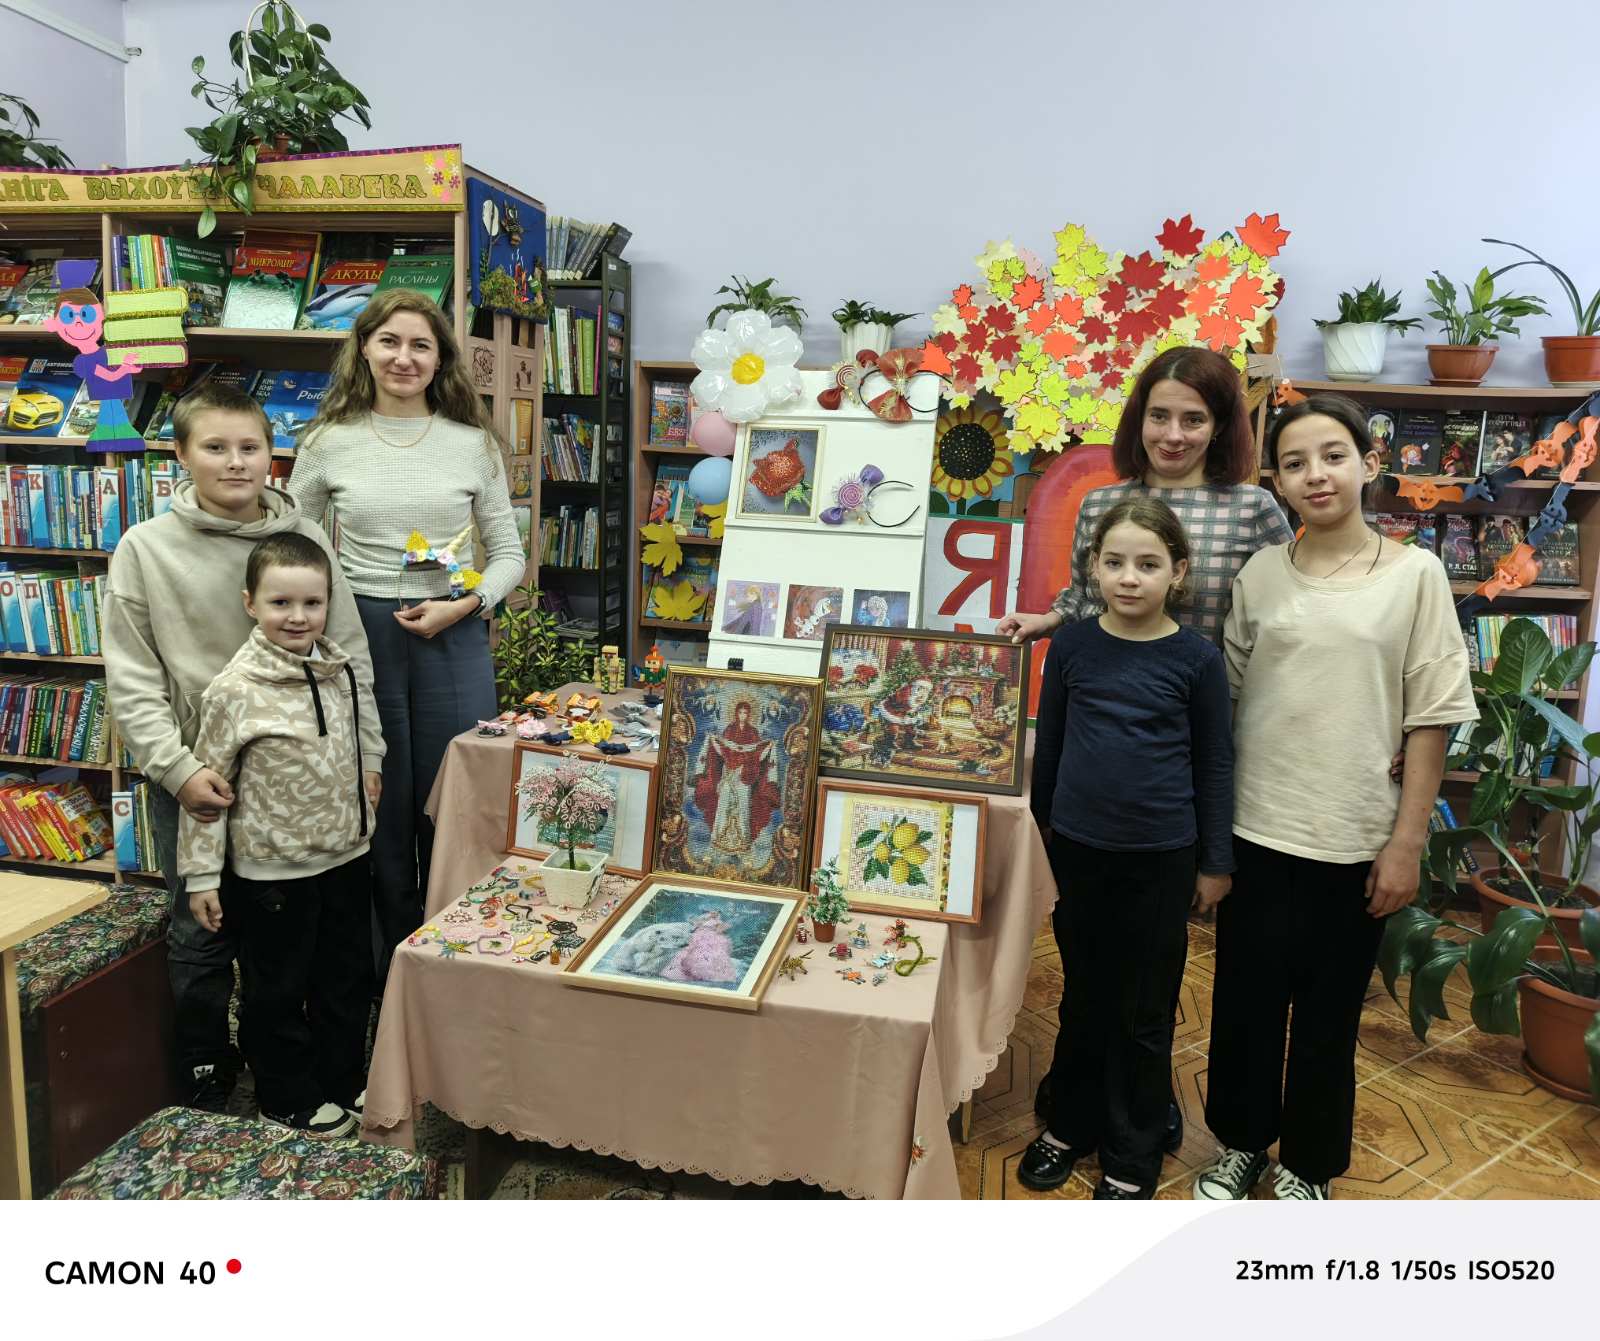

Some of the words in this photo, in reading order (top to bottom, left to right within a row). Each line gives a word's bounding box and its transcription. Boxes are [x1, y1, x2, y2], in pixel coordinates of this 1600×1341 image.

[256, 173, 427, 199] ЧАЛАВЕКА
[388, 274, 440, 285] РАСЛІНЫ
[29, 473, 43, 491] К
[102, 478, 117, 496] А
[938, 519, 1012, 620] Я
[0, 581, 13, 597] О
[24, 582, 38, 599] П
[114, 801, 130, 817] С
